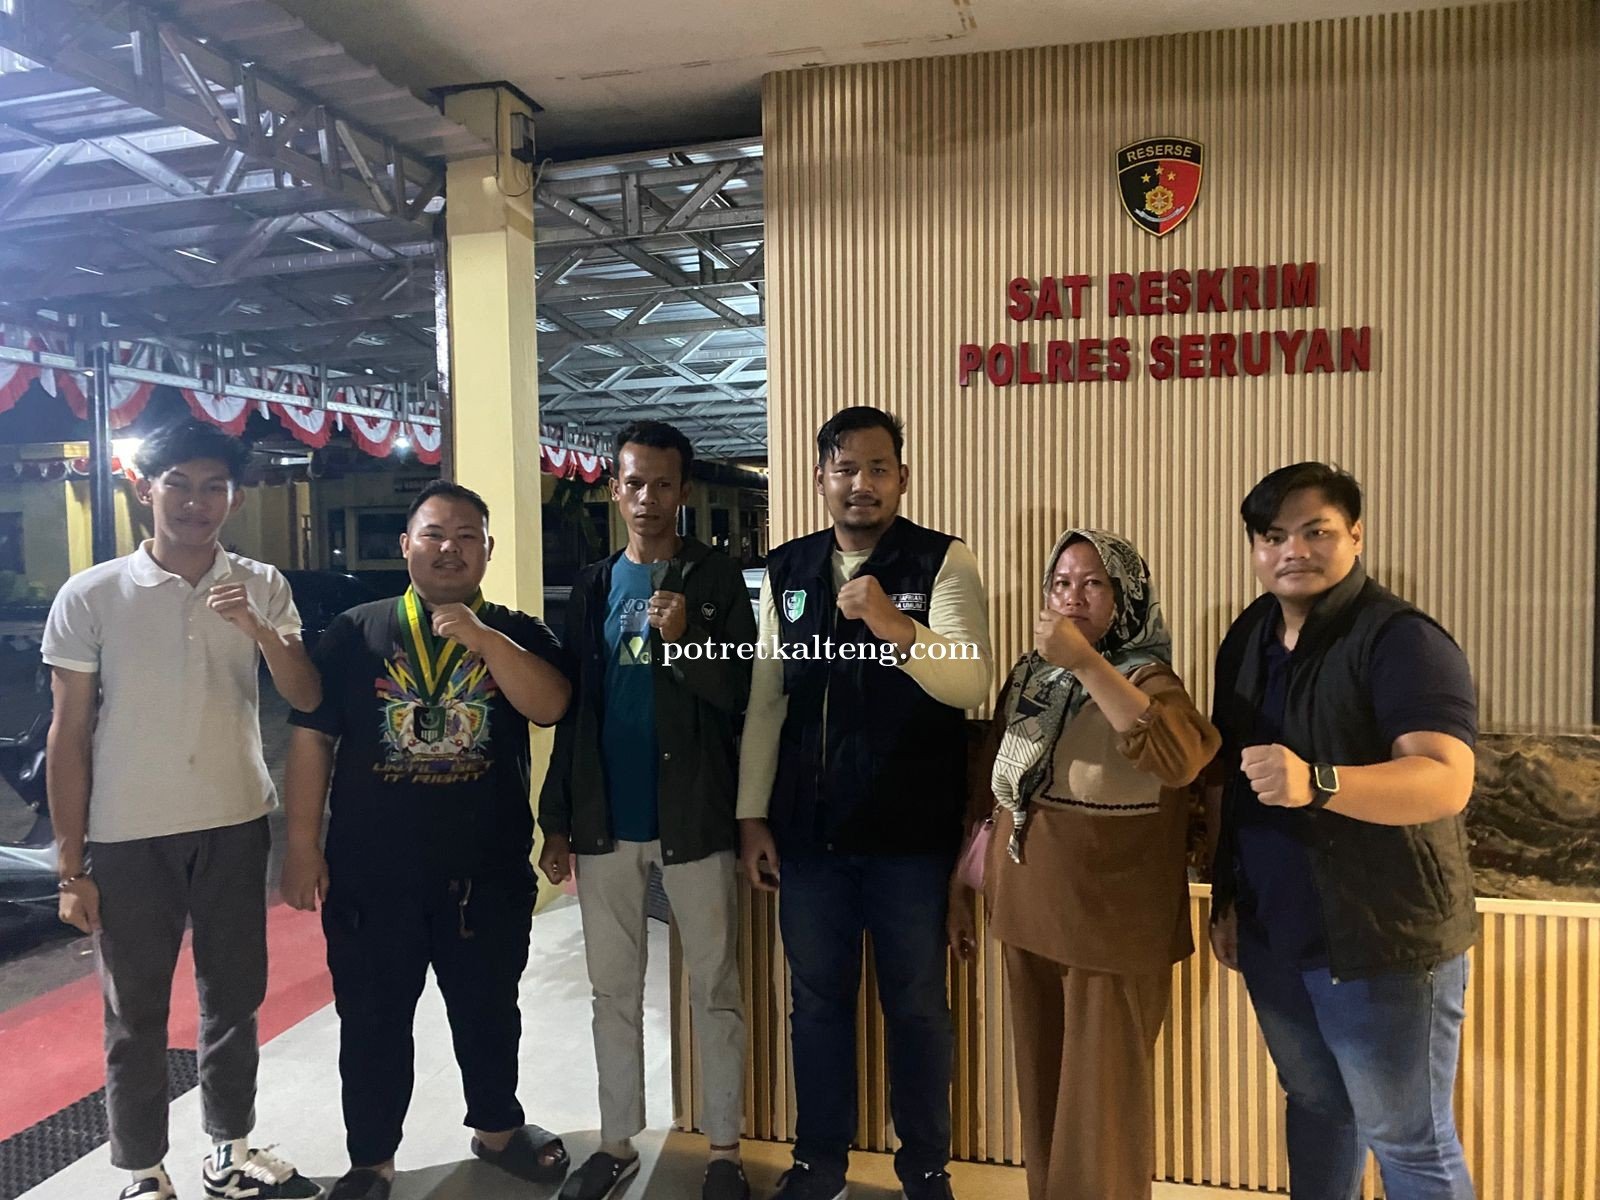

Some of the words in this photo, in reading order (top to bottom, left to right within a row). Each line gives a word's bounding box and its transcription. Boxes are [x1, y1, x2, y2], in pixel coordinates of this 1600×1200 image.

[1126, 144, 1193, 162] RESERSE
[1007, 274, 1090, 321] SAT
[1108, 262, 1318, 317] RESKRIM
[959, 337, 1131, 386] POLRES
[1149, 326, 1371, 380] SERUYAN
